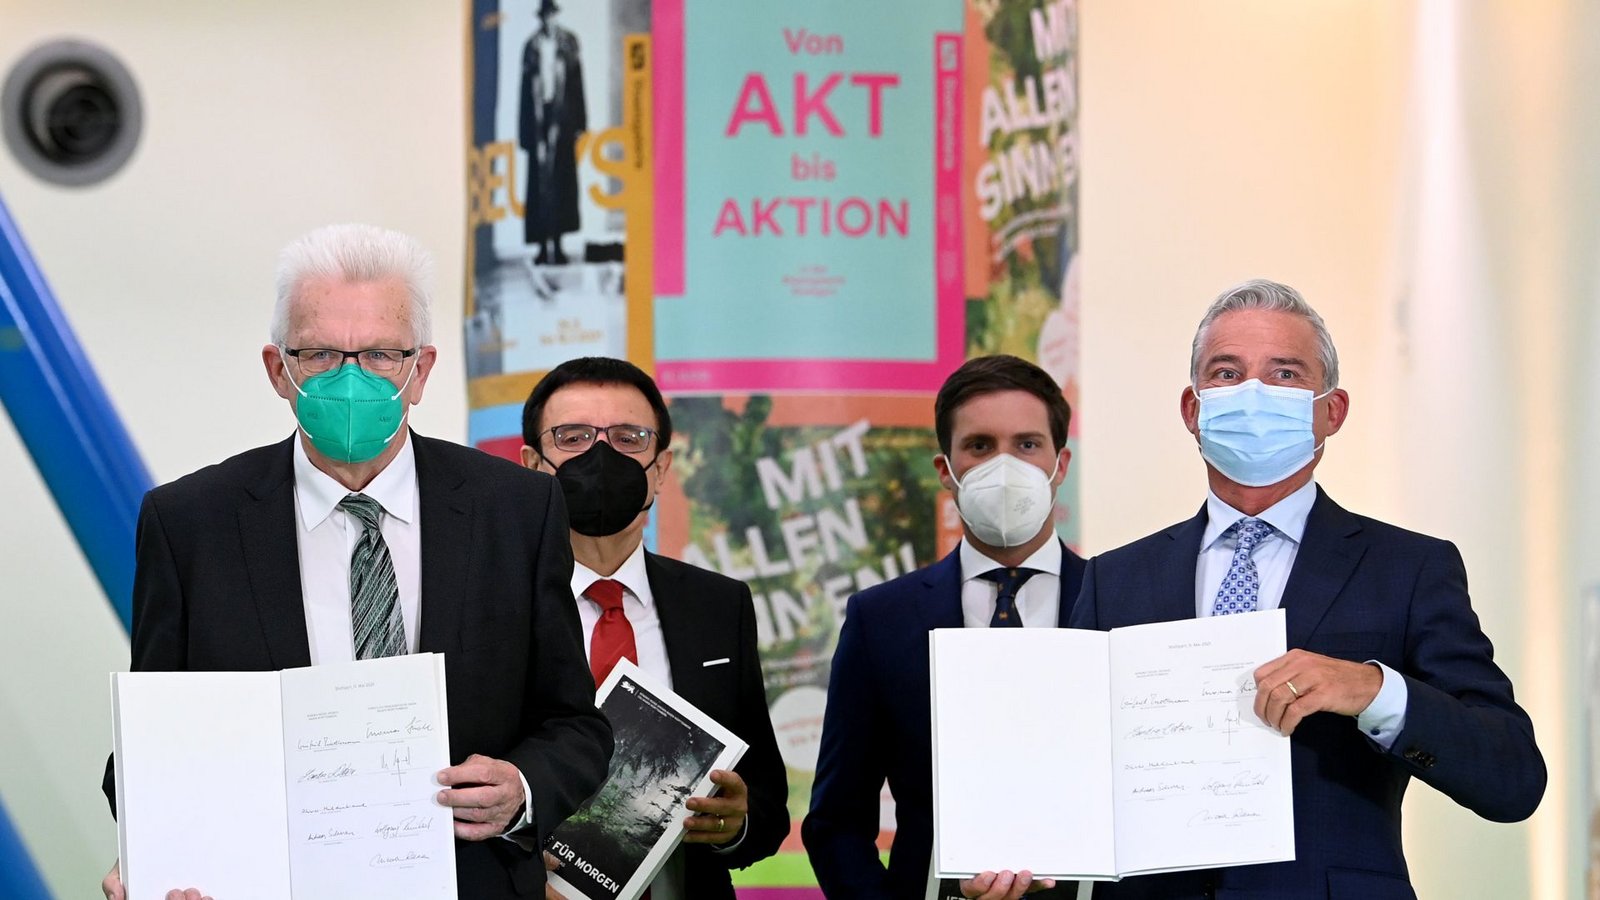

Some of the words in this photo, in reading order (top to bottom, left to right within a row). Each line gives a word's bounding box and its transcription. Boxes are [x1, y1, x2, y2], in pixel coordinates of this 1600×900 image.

[783, 27, 843, 54] Von
[725, 71, 900, 137] AKT
[791, 152, 836, 181] bis
[713, 197, 909, 238] AKTION
[755, 419, 871, 509] MIT
[552, 840, 576, 863] FÜR
[574, 856, 620, 894] MORGEN
